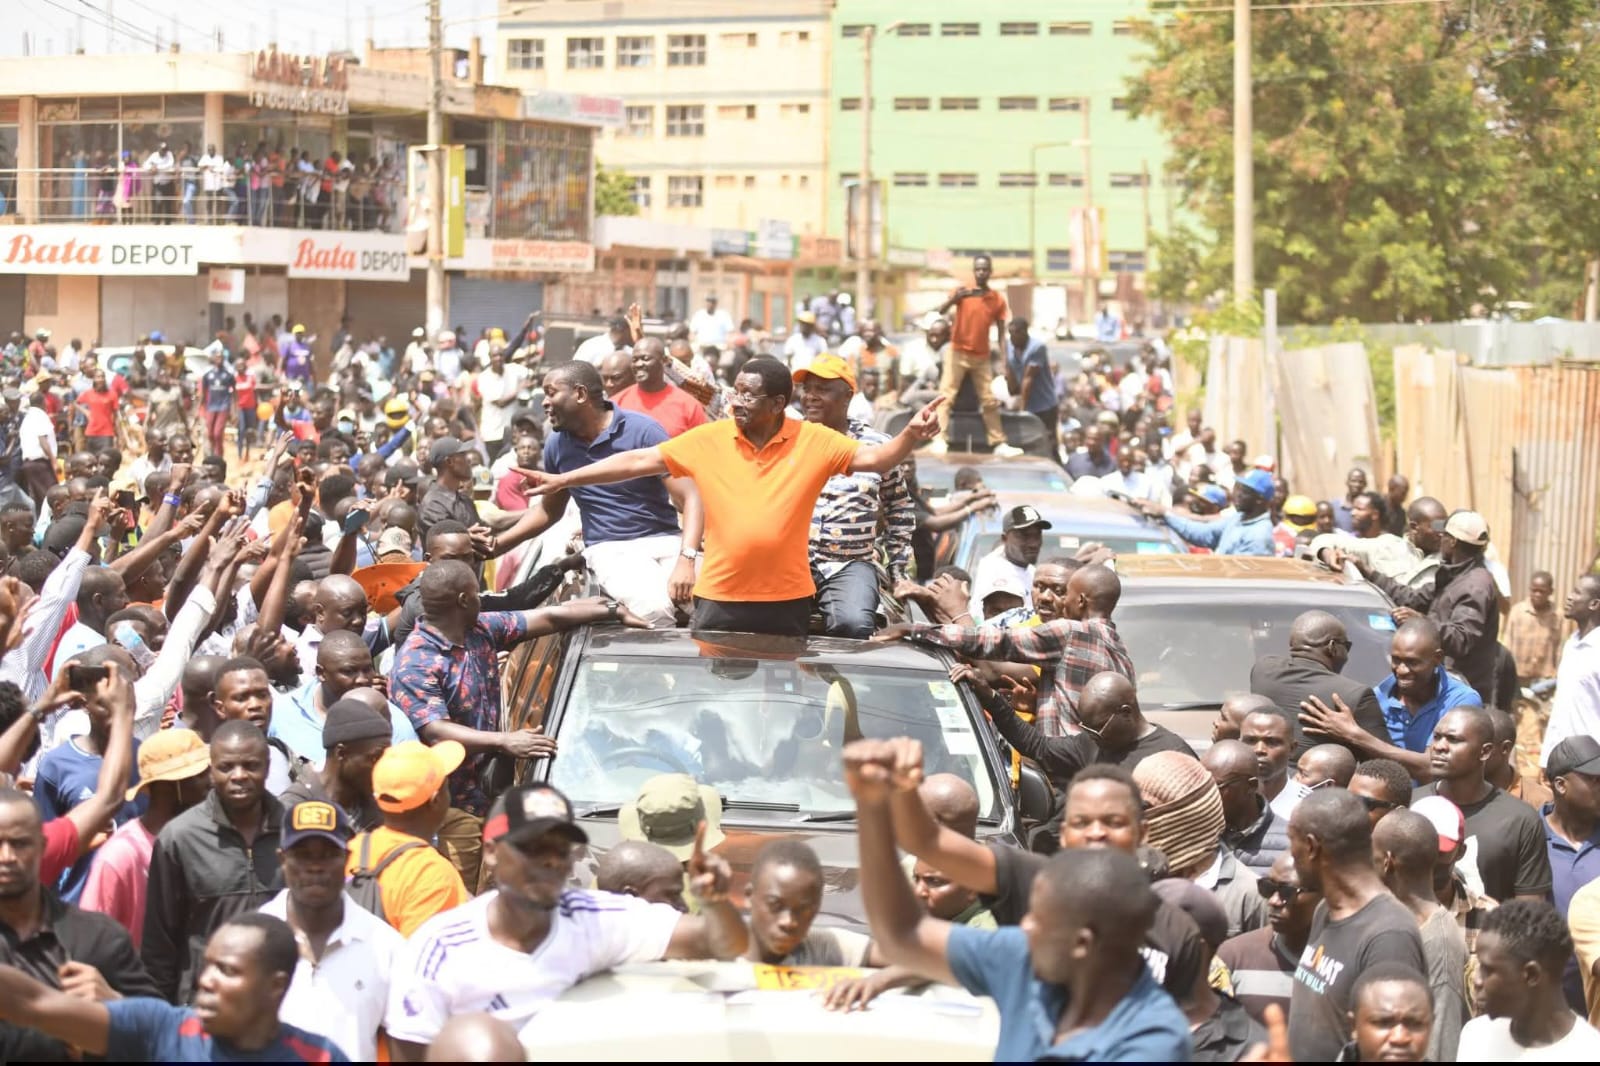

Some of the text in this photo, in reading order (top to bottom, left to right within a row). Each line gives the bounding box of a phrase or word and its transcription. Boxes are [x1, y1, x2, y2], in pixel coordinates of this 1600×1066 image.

[4, 234, 193, 265] Bata DEPOT
[294, 238, 407, 273] Bata DEPOT
